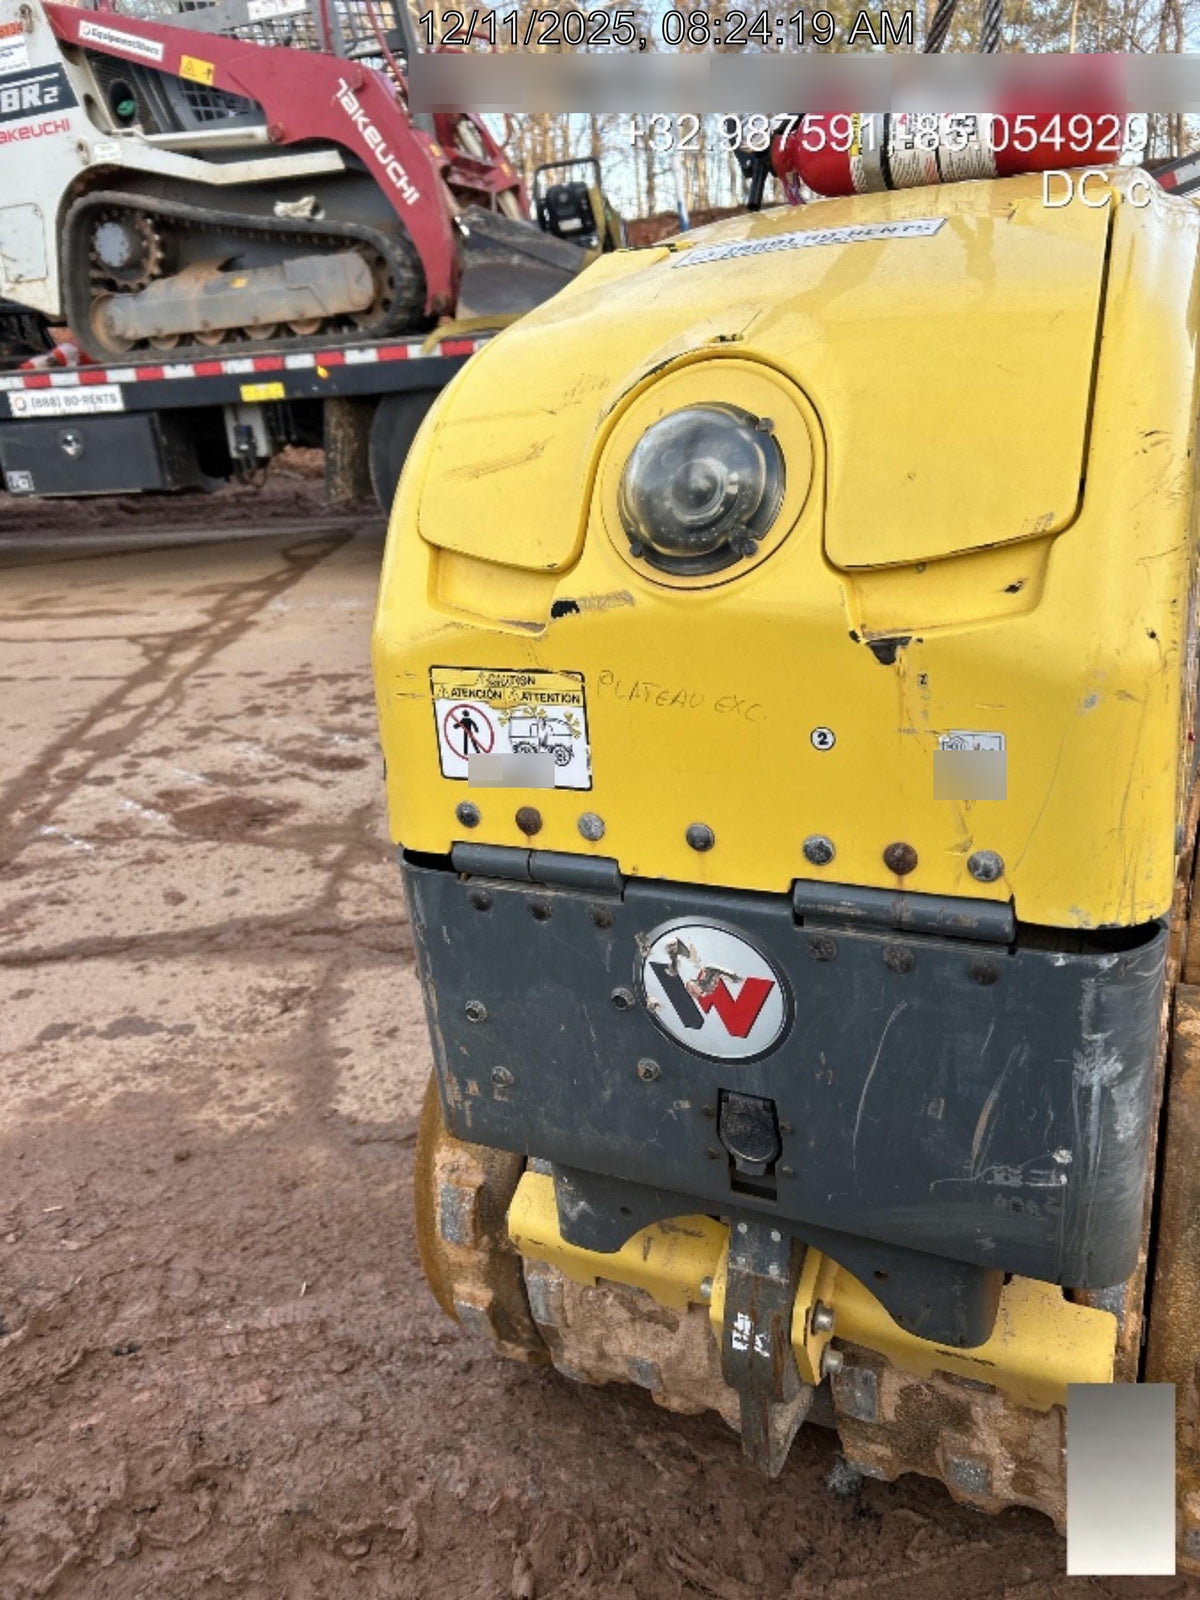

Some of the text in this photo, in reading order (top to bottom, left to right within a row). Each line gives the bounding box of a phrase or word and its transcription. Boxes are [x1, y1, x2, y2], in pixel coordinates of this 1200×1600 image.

[336, 77, 420, 206] TAKEUCHI
[520, 691, 580, 704] ATTENTION
[597, 669, 704, 709] PLATEAU
[817, 731, 829, 746] 2
